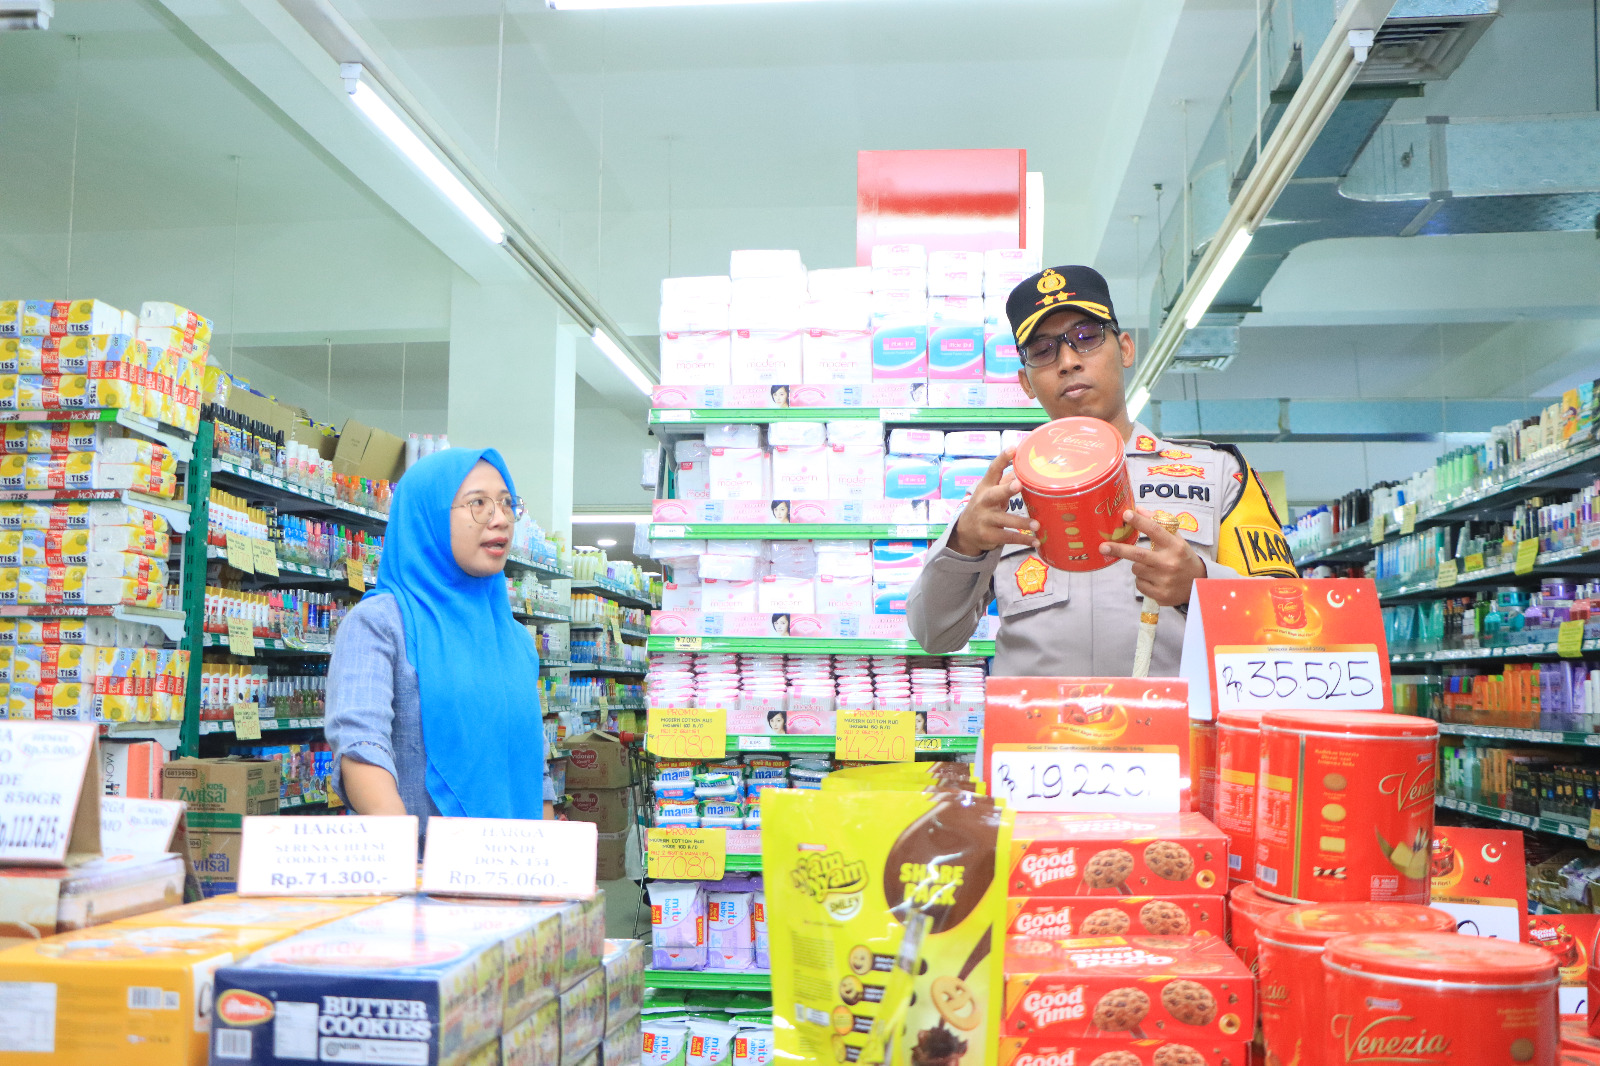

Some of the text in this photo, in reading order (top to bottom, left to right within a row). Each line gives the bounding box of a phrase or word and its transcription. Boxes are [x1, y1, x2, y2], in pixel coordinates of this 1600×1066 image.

[0, 324, 15, 332] TISS
[676, 360, 714, 369] modern
[819, 360, 858, 368] modern
[717, 480, 752, 488] modern
[781, 474, 818, 482] modern
[838, 475, 874, 484] modern
[77, 491, 115, 500] MONTISS
[686, 488, 710, 498] mode
[1140, 483, 1210, 502] POLRI
[1247, 530, 1296, 567] KAO
[50, 607, 88, 616] MONTISS
[1247, 660, 1374, 701] 35.525
[662, 770, 690, 781] mama
[755, 770, 784, 779] mama
[101, 803, 125, 814] RGA
[664, 806, 693, 817] mama
[707, 804, 736, 815] mama
[293, 822, 368, 836] HARGA
[482, 826, 545, 838] HARGA
[666, 828, 698, 836] PROMO
[484, 844, 537, 854] MONDE
[1021, 849, 1075, 873] Good
[270, 870, 390, 890] Rp.71.300,-
[899, 862, 965, 886] SHARE
[1031, 863, 1077, 888] Time
[672, 898, 681, 922] mitu
[728, 902, 738, 924] mitu
[1016, 907, 1070, 932] Good
[321, 995, 429, 1020] BUTTER
[1023, 986, 1083, 1013] Good
[1034, 1003, 1085, 1028] Time
[318, 1014, 432, 1041] COOKIES
[653, 1036, 661, 1053] baby
[702, 1036, 711, 1054] baby
[1331, 1014, 1450, 1063] Venezia
[660, 1036, 670, 1060] mitu
[710, 1038, 720, 1062] mitu
[758, 1038, 768, 1062] mitu
